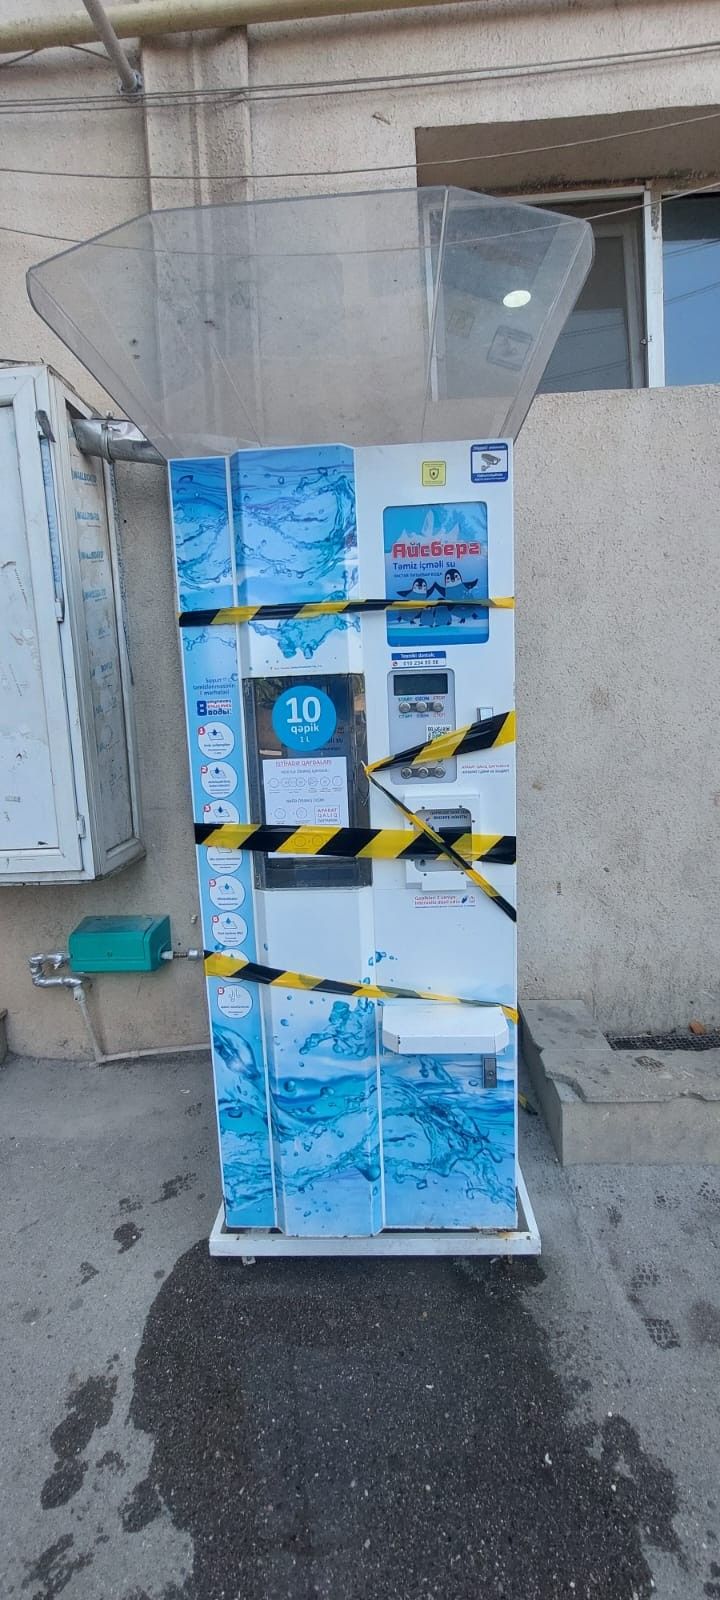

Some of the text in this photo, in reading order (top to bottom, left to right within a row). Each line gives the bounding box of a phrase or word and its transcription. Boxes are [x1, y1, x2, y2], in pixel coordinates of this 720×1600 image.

[393, 540, 480, 559] Айсберг
[393, 562, 417, 570] Təmiz
[419, 561, 444, 570] içməli
[286, 696, 321, 723] 10
[290, 723, 319, 734] qəpik
